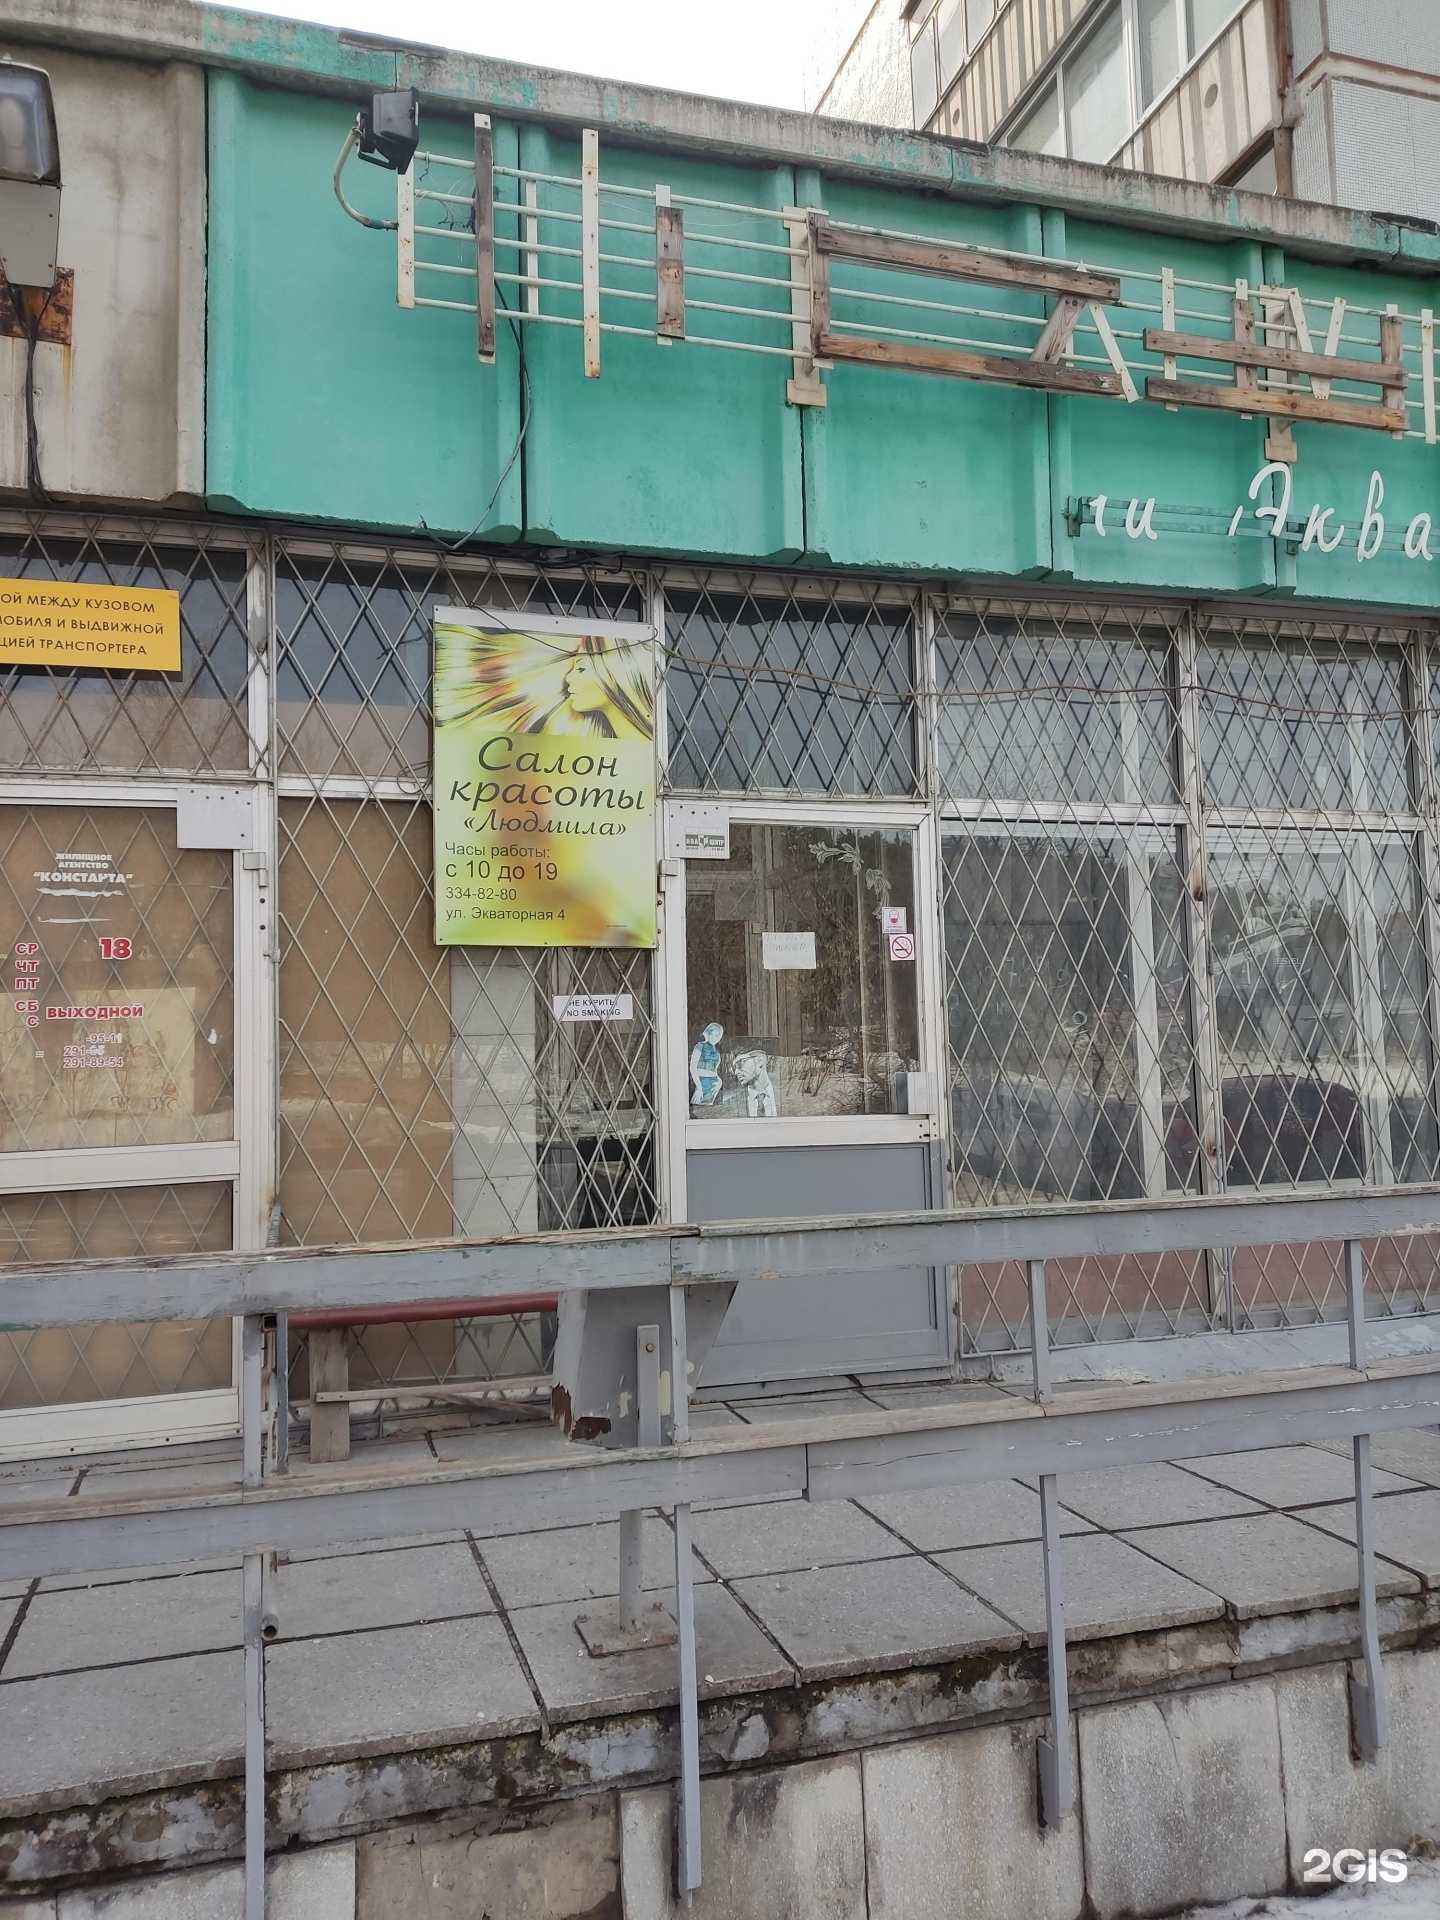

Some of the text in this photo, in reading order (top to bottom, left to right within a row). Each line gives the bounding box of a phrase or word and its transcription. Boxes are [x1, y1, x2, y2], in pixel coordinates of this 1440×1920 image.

[27, 595, 81, 608] МЕЖДУ
[86, 599, 155, 613] КУЗОВОМ
[57, 618, 66, 629] И
[71, 620, 164, 635] ВЫДВИЖНОЙ
[40, 639, 147, 655] ТРАНСПОРТЕРА
[478, 736, 618, 777] Салон
[450, 780, 645, 810] красоты
[464, 809, 626, 835] «Людмила»
[445, 842, 550, 859] Часы работы:
[466, 860, 490, 878] 10
[498, 864, 525, 881] до
[534, 862, 558, 880] 19
[445, 887, 517, 901] 334-82-80
[446, 907, 566, 922] ул. Экваторная 4
[15, 936, 133, 960] СР 18
[15, 959, 39, 972] ЧТ
[15, 977, 39, 989] ПТ
[15, 1001, 144, 1019] СБ ВЫХОДНОЙ
[582, 1008, 621, 1017] SMOKING
